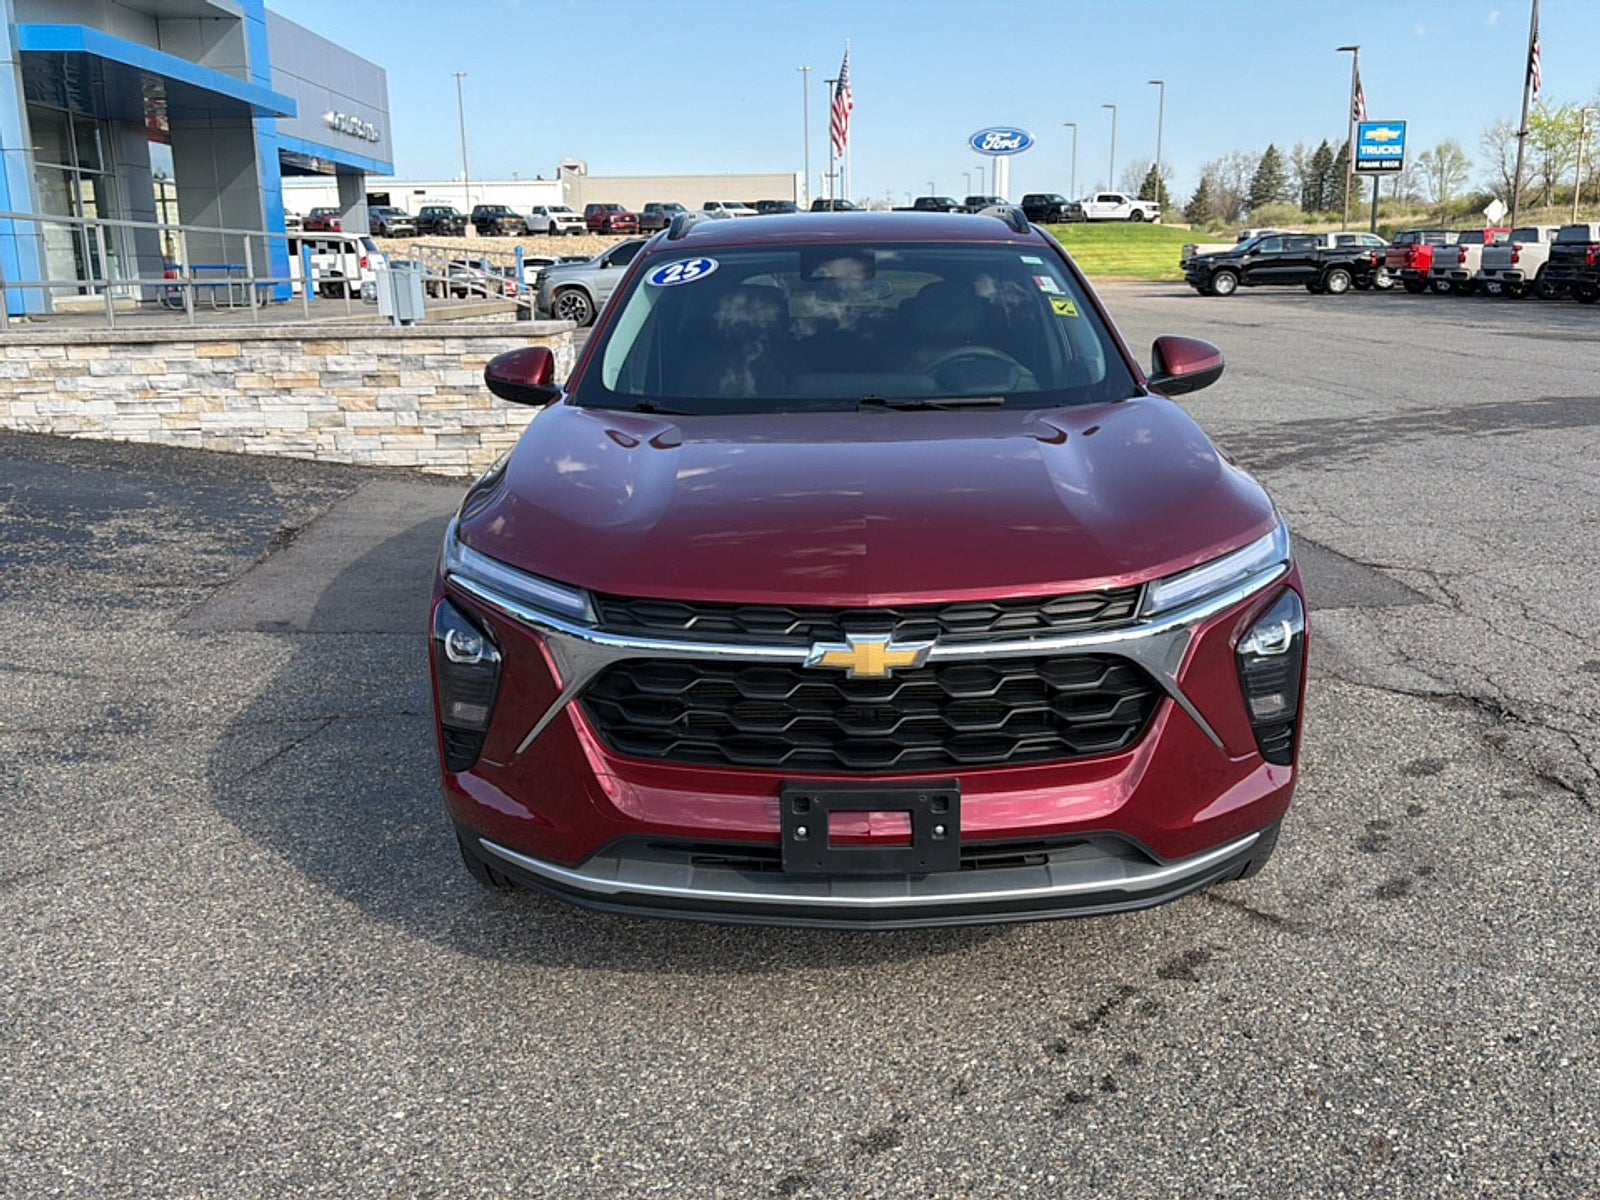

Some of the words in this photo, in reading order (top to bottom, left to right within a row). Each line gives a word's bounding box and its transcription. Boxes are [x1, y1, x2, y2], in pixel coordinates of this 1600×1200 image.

[983, 133, 1020, 149] Ford
[1360, 145, 1402, 155] TRUCKS
[663, 260, 701, 282] 25
